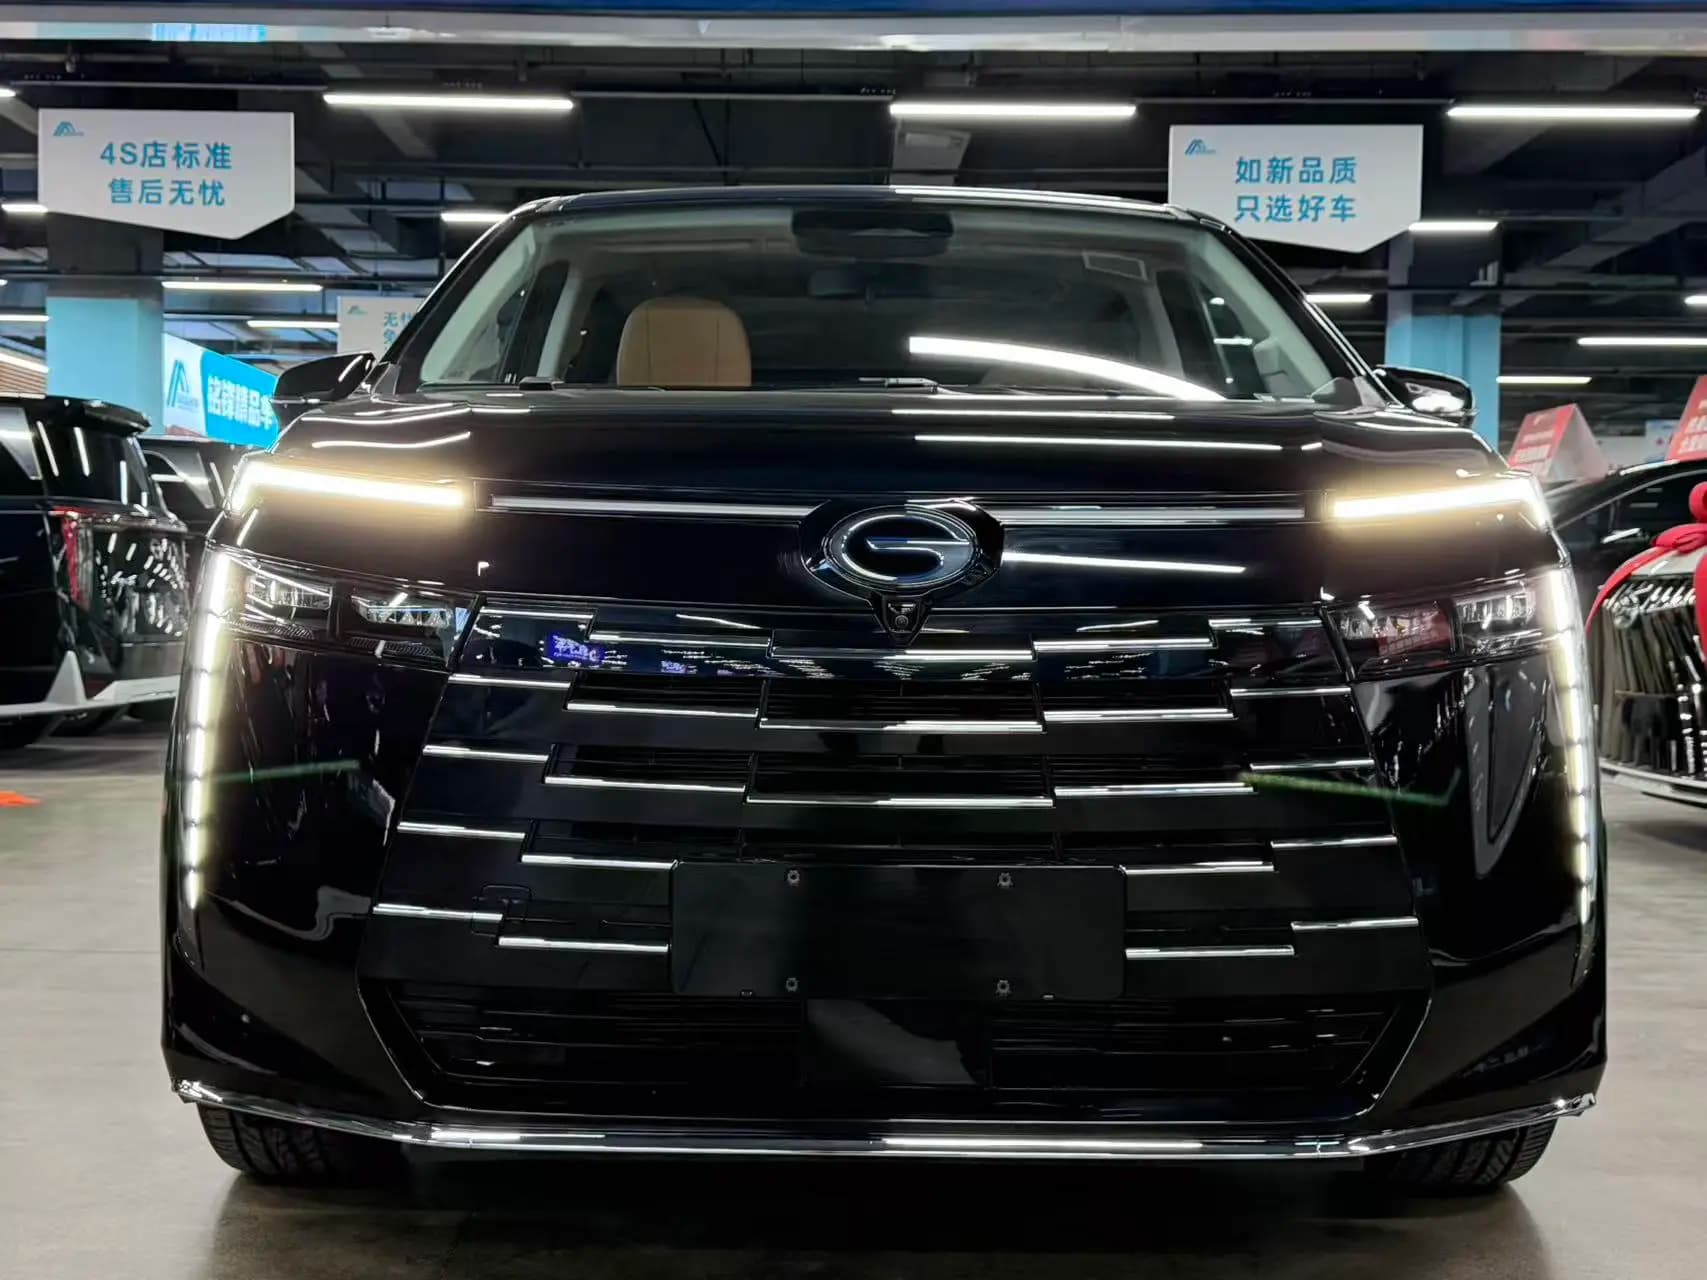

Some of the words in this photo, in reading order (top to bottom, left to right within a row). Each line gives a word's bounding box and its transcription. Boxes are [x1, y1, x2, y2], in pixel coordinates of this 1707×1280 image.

[100, 141, 232, 170] 4S店标准
[1235, 157, 1358, 184] 如新品质
[107, 177, 226, 206] 售后无忧
[1234, 195, 1357, 222] 只选好车
